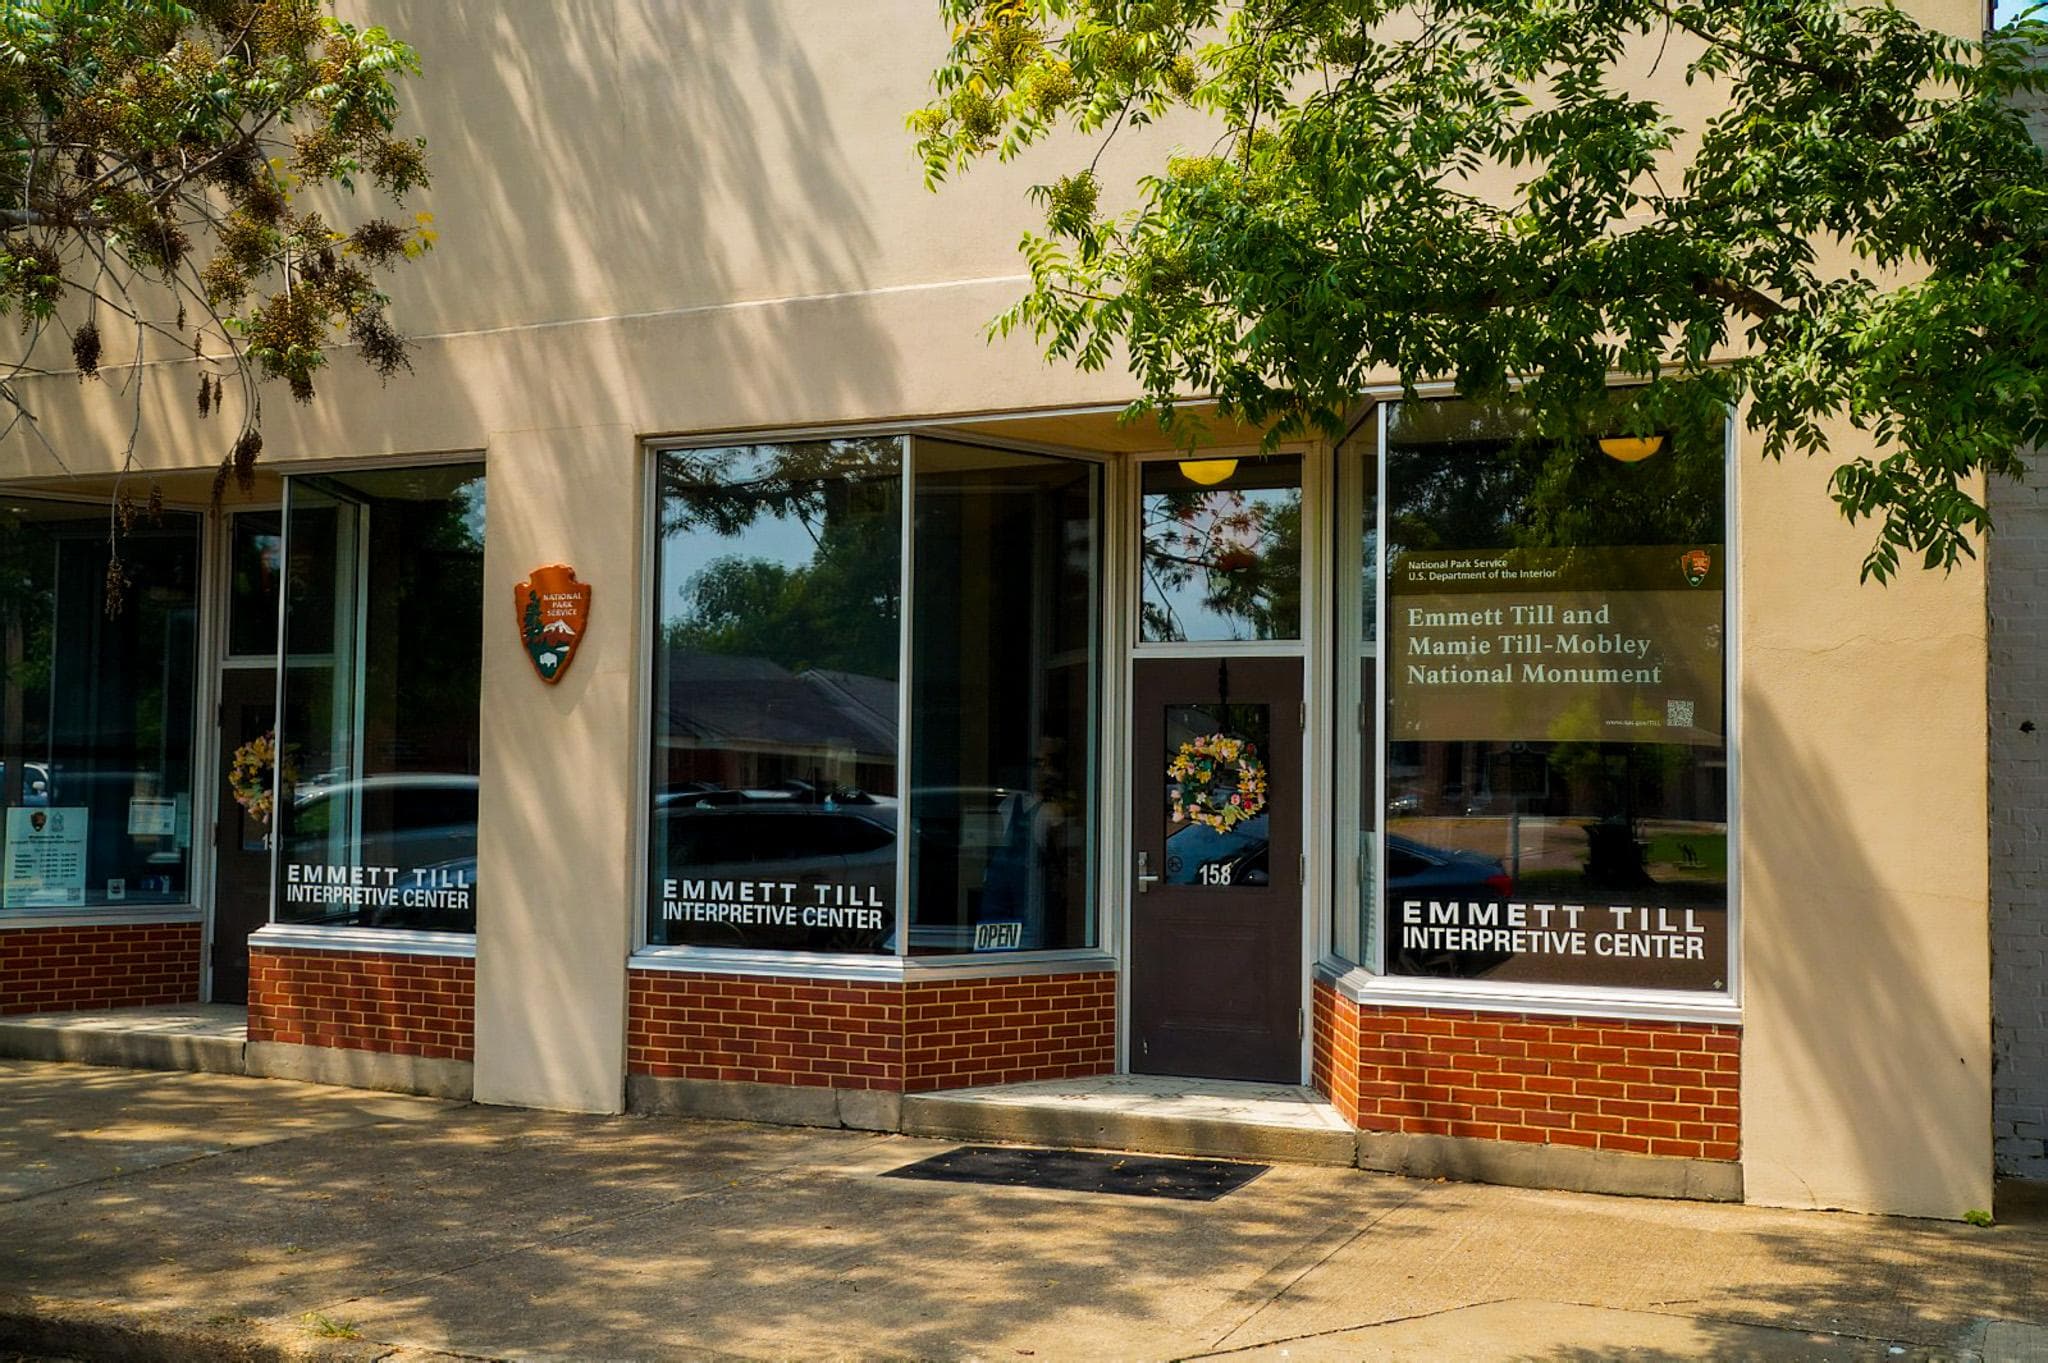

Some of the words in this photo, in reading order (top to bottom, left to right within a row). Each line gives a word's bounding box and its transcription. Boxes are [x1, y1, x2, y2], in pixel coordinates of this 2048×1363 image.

[1408, 560, 1448, 569] National
[1451, 559, 1472, 568] Park
[1474, 559, 1508, 568] Service
[1408, 571, 1427, 581] U.S.
[1429, 570, 1486, 582] Department
[1488, 569, 1499, 579] of
[1501, 569, 1518, 578] the
[1520, 568, 1557, 578] Interior
[543, 592, 582, 600] NATIONAL
[546, 608, 578, 617] SERVICE
[1408, 607, 1503, 627] Emmett
[1510, 605, 1554, 625] Till
[1562, 604, 1610, 625] and
[1407, 635, 1491, 655] Mamie
[1498, 633, 1652, 659] Till-Mobley
[1407, 663, 1513, 684] National
[1522, 663, 1662, 684] Monument
[287, 864, 399, 886] EMMETT
[412, 868, 470, 889] TILL
[1199, 863, 1231, 886] 158
[286, 884, 399, 906] INTERPRETIVE
[403, 888, 470, 910] CENTER
[663, 878, 797, 904] EMMETT
[814, 884, 883, 907] TILL
[662, 901, 798, 926] INTERPRETIVE
[801, 906, 883, 930] CENTER
[1402, 900, 1585, 929] EMMETT
[1609, 906, 1706, 934] TILL
[978, 923, 1019, 949] OPEN
[1402, 926, 1587, 955] INTERPRETIVE
[1594, 932, 1705, 960] CENTER
